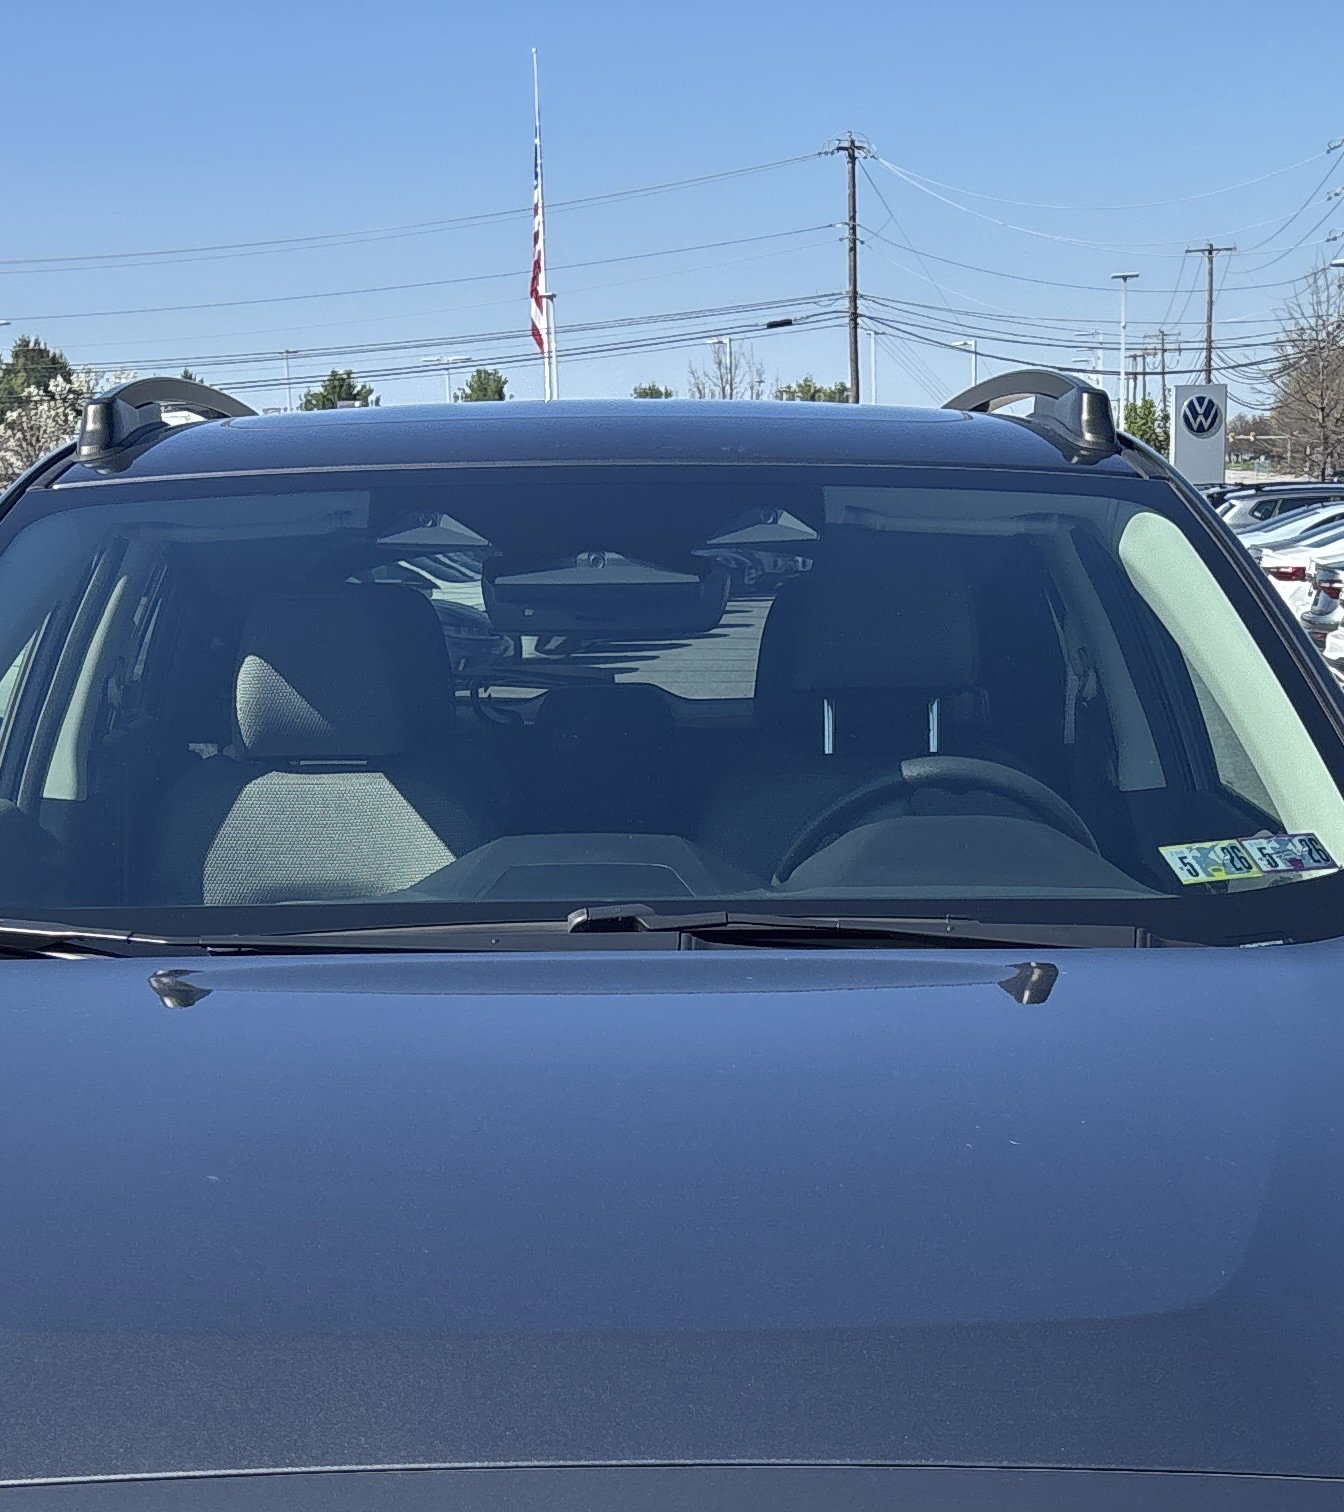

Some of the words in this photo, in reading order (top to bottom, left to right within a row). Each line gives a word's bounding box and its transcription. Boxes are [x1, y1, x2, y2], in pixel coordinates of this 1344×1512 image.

[1183, 395, 1220, 433] VW
[1177, 855, 1200, 878] 5
[1221, 845, 1253, 872] 26
[1257, 846, 1279, 868] 5
[1298, 837, 1331, 863] 26
